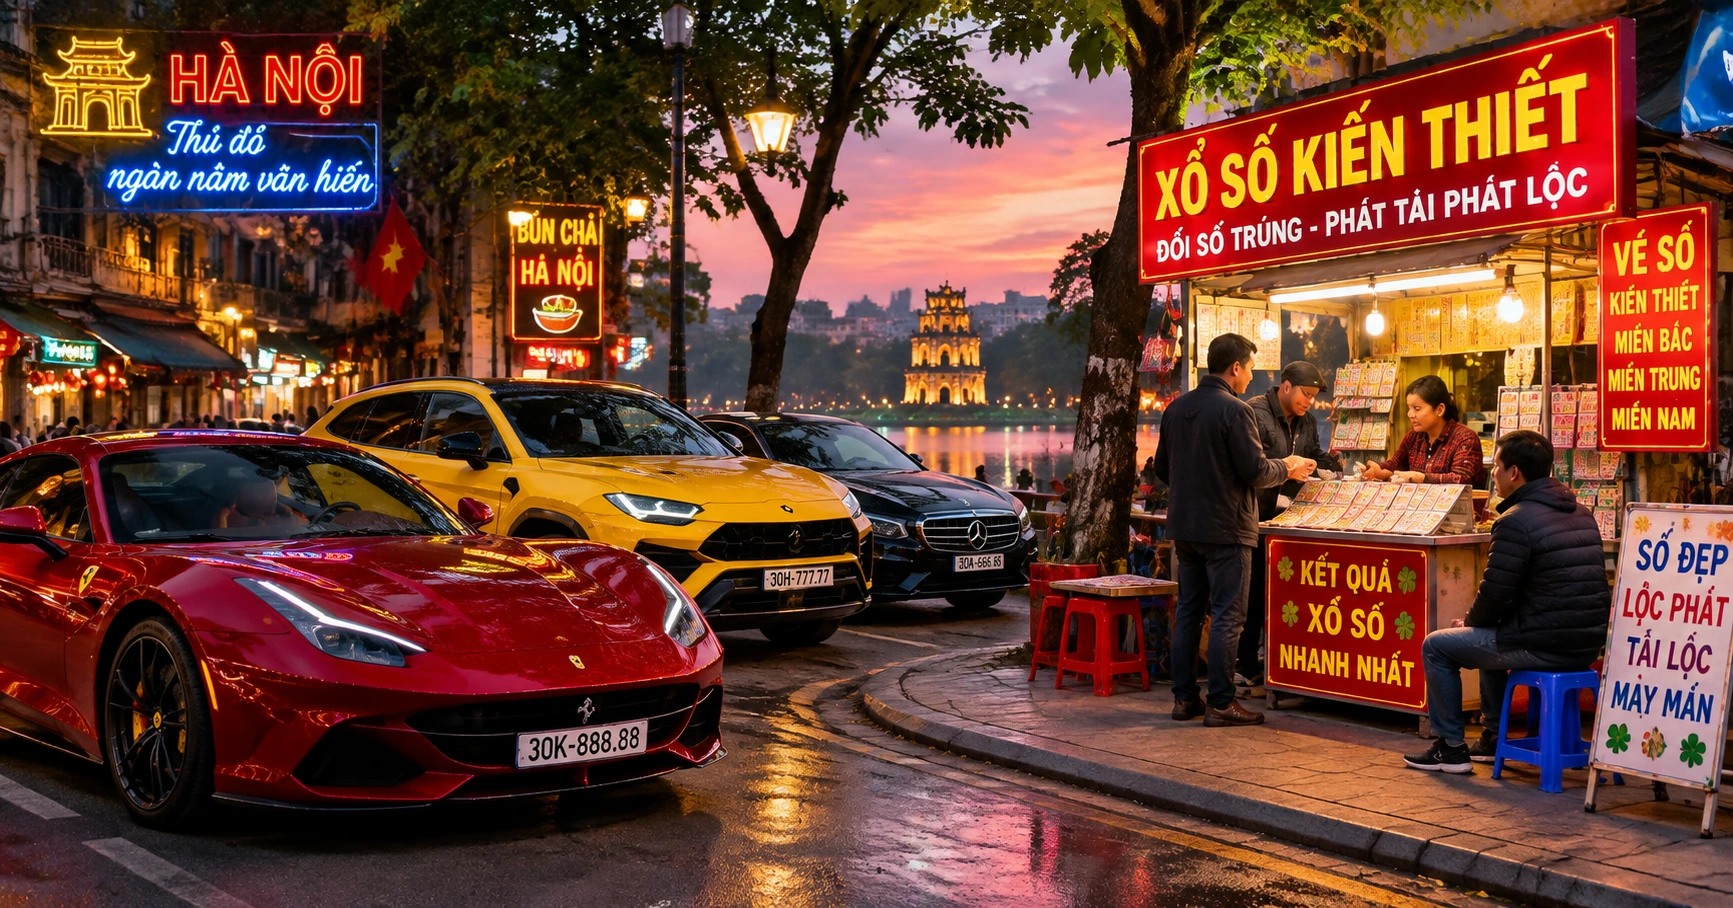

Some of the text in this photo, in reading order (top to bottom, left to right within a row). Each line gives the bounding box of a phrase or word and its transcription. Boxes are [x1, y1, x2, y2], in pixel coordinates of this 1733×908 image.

[170, 41, 362, 115] HÀ NỘI
[1155, 53, 1587, 221] XỔ SỐ KIẾN THIẾT
[313, 158, 374, 193] hiến
[517, 210, 555, 245] BÚN
[1156, 226, 1190, 263] ĐỐI
[1196, 220, 1225, 257] SỐ
[1231, 215, 1302, 251] TRÚNG
[1657, 219, 1695, 273] SỐ
[1649, 365, 1701, 391] TRUNG
[1657, 406, 1696, 431] NAM
[770, 568, 830, 588] 30H-777.77
[1300, 551, 1340, 588] KẾT
[1677, 541, 1729, 585] ĐẸP
[1350, 601, 1385, 641] SỐ
[1279, 643, 1415, 688] NHANH NHẤT
[528, 726, 640, 762] 30K-888.88
